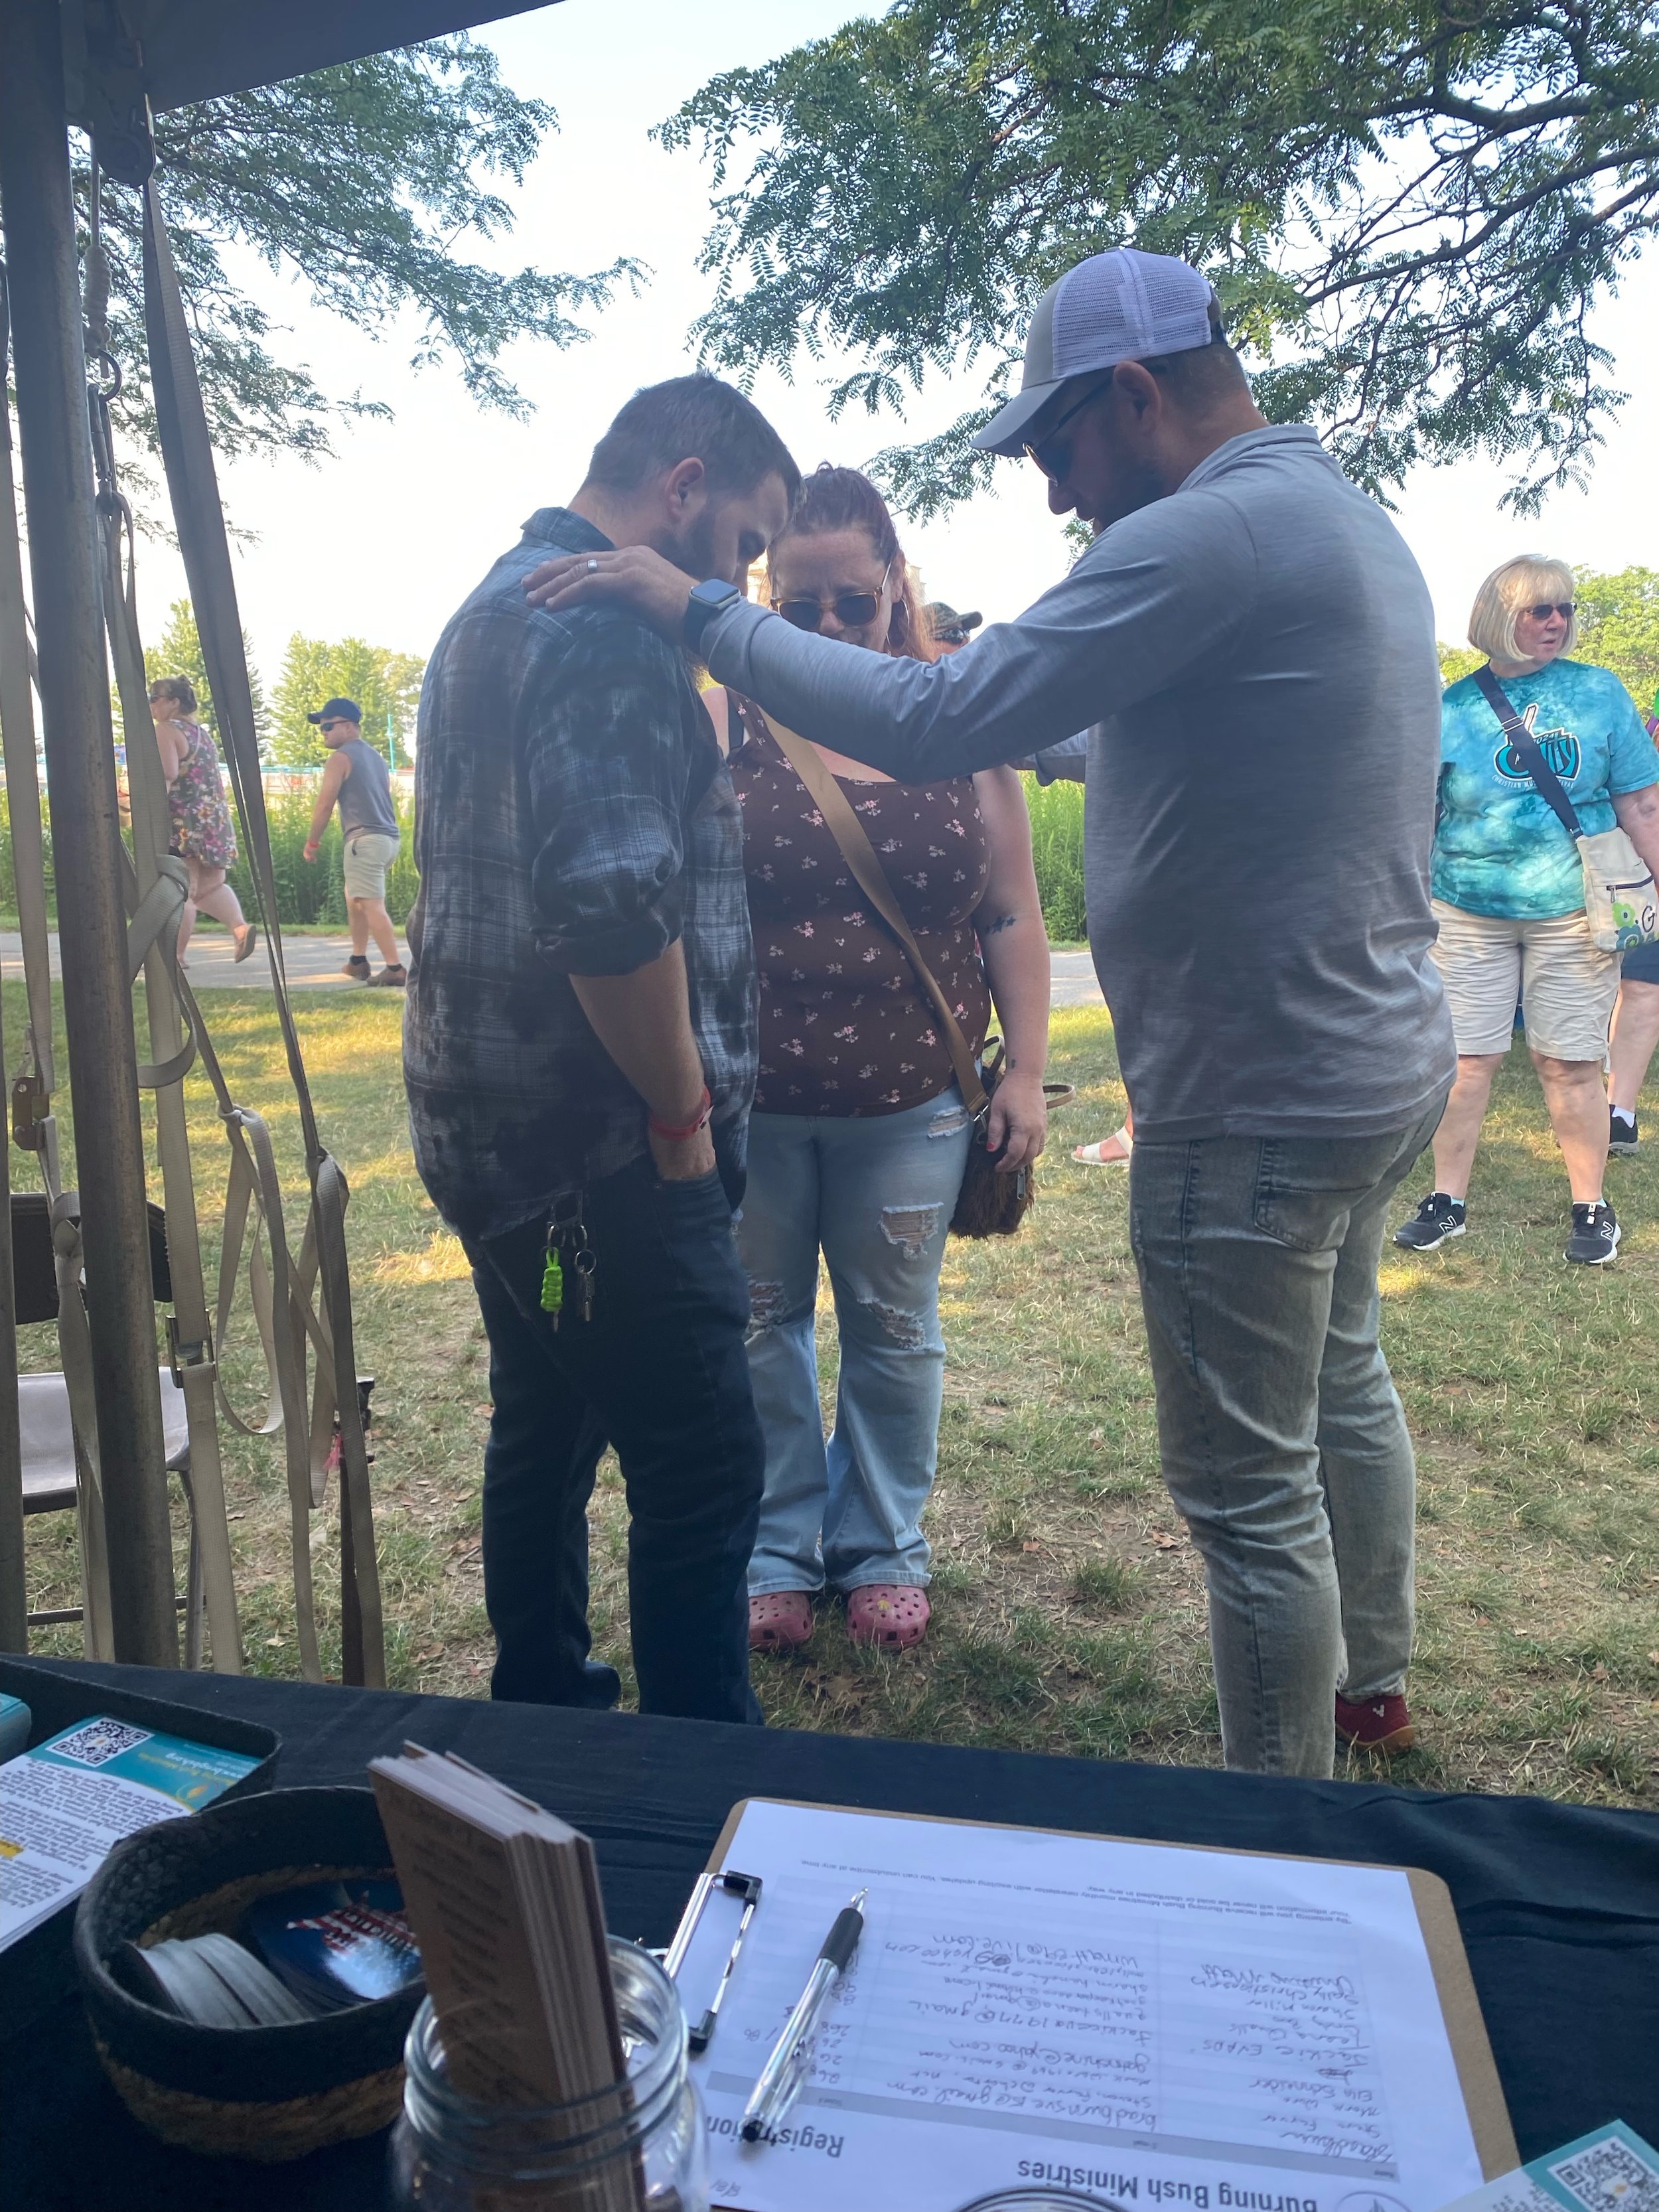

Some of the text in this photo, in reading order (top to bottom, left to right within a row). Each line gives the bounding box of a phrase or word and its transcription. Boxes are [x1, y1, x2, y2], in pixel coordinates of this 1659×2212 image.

[1492, 774, 1522, 788] CHRISTIAN
[706, 2116, 844, 2158] Registrion
[1017, 2160, 1138, 2199] Ministries
[1147, 2178, 1208, 2209] Bush
